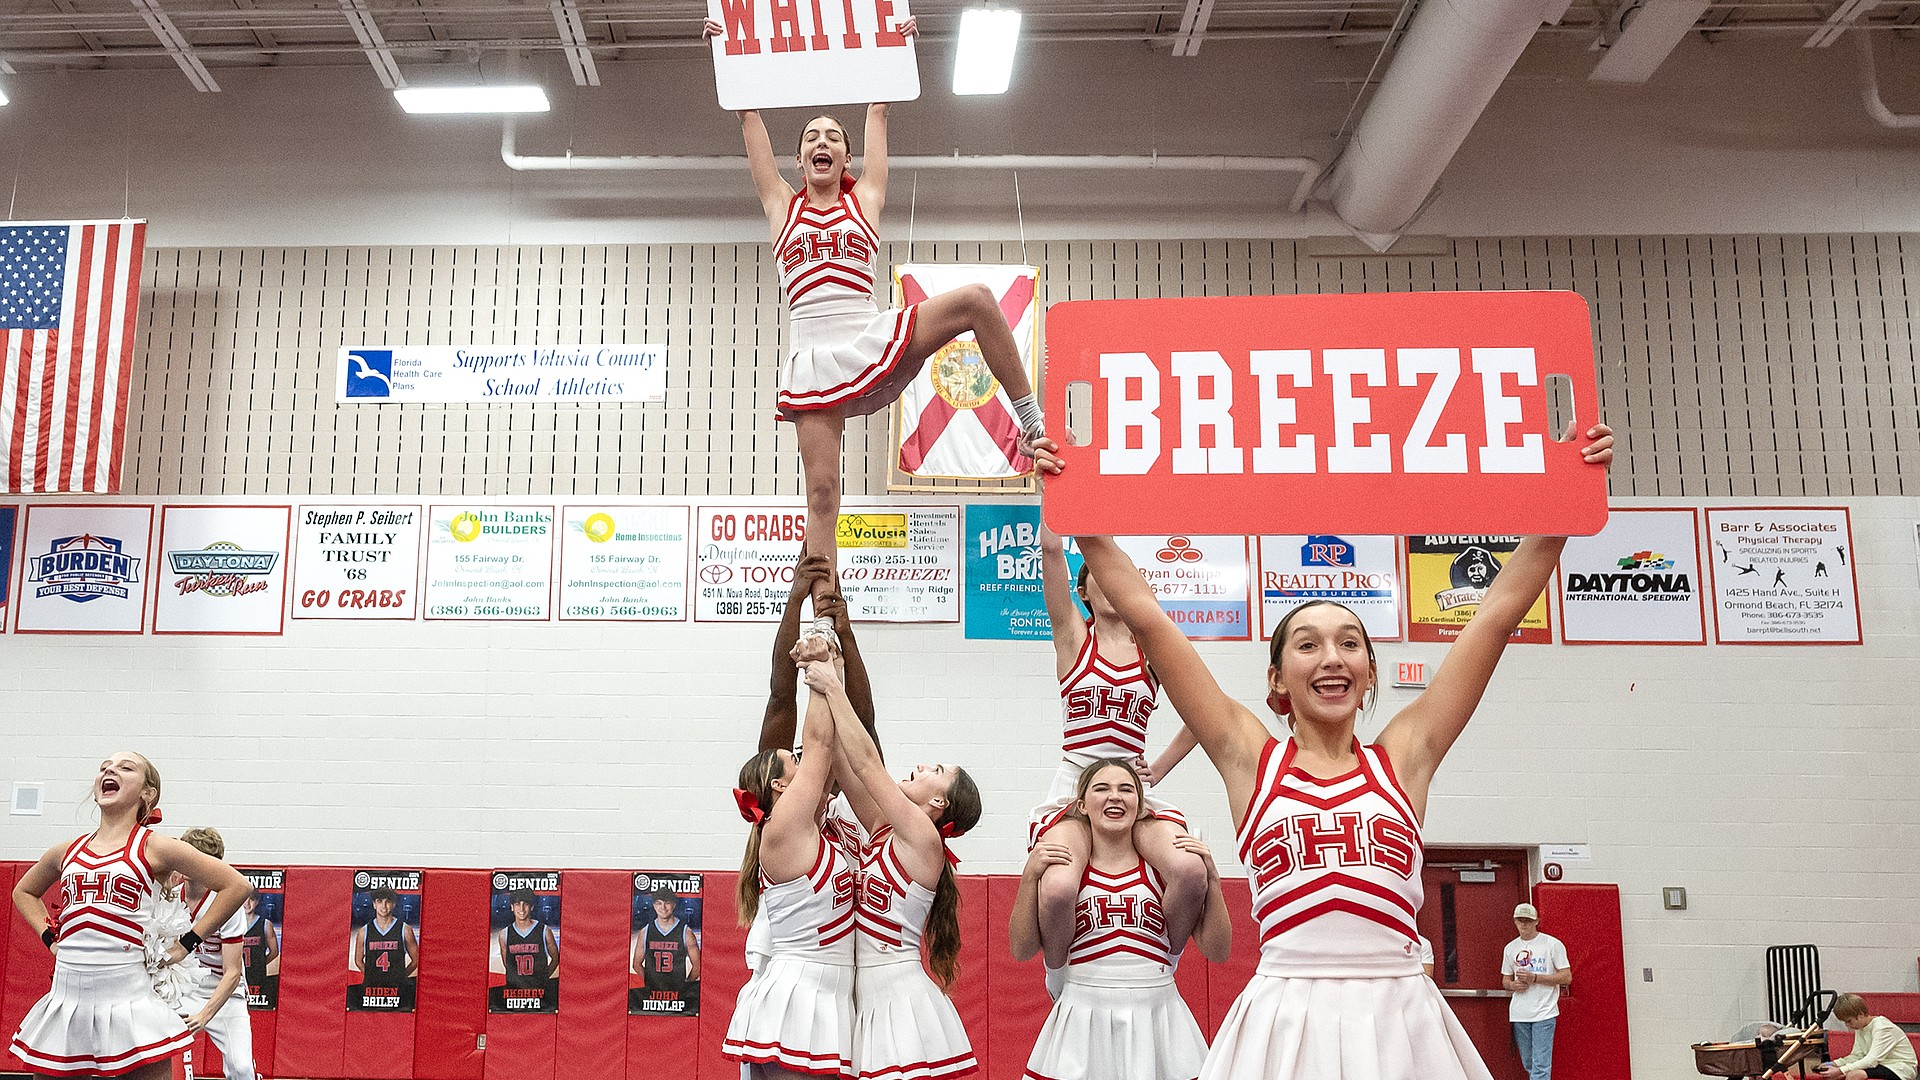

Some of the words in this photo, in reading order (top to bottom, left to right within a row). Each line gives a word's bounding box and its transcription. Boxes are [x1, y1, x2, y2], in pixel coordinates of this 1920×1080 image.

[782, 230, 870, 278] SHS
[453, 350, 526, 373] Supports
[534, 349, 589, 367] Volusia
[596, 349, 656, 370] County
[483, 378, 540, 396] School
[549, 378, 625, 396] Athletics
[1099, 347, 1546, 475] BREEZE
[306, 511, 352, 528] Stephen
[356, 511, 365, 524] P.
[370, 511, 413, 524] Seibert
[460, 511, 498, 522] John
[504, 511, 551, 522] Banks
[483, 526, 546, 534] BUILDERS
[712, 515, 736, 541] GO
[745, 515, 805, 541] CRABS
[854, 528, 906, 539] Volusia
[1721, 523, 1749, 532] Barr
[1755, 523, 1764, 532] &
[1769, 523, 1837, 532] Associates
[318, 532, 397, 544] FAMILY
[615, 533, 636, 541] Home
[638, 533, 682, 542] Inspections
[1425, 536, 1522, 545] ADVENTURE
[1738, 536, 1778, 545] Physical
[1783, 536, 1822, 545] Therapy
[323, 550, 391, 562] TRUST
[455, 555, 470, 563] 155
[473, 555, 509, 564] Fairway
[512, 555, 524, 563] Dr.
[590, 555, 605, 563] 155
[609, 555, 644, 564] Fairway
[648, 555, 660, 563] Dr.
[704, 544, 757, 565] Daytona
[852, 555, 881, 565] (386)
[885, 555, 937, 565] 255-1100
[1309, 544, 1352, 567] RP
[41, 553, 127, 576] BURDEN
[179, 556, 266, 568] DAYTONA
[344, 568, 367, 580] '68
[740, 567, 795, 583] TOYO
[842, 568, 867, 581] GO
[871, 568, 951, 581] BREEZE!
[1139, 568, 1170, 581] Ryan
[1176, 568, 1221, 581] Ochipa
[175, 570, 235, 595] Turkey
[232, 578, 267, 596] Run
[432, 580, 544, 589] JohnInspection@aol.com
[568, 580, 682, 589] JohnInspection@aol.com
[980, 584, 1002, 592] REEF
[1005, 584, 1043, 592] FRIENDL
[1264, 571, 1337, 594] REALTY
[1342, 571, 1391, 589] PROS
[1568, 573, 1690, 593] DAYTONA
[39, 586, 61, 595] YOUR
[86, 585, 126, 596] DEFENSE
[703, 588, 715, 598] 451
[717, 588, 724, 598] N.
[727, 588, 742, 598] Nova
[745, 588, 762, 599] Road,
[929, 586, 953, 594] Ridge
[1150, 584, 1226, 594] 6-677-1119
[302, 590, 330, 608] GO
[338, 590, 406, 609] CRABS
[1443, 591, 1483, 606] Pirate's
[431, 606, 468, 616] (386)
[474, 606, 540, 616] 566-0963
[567, 606, 604, 616] (386)
[610, 606, 677, 616] 566-0963
[717, 602, 742, 614] (386)
[747, 602, 787, 614] 255-74
[1725, 601, 1762, 609] Ormond
[1766, 601, 1797, 610] Beach,
[1800, 601, 1811, 609] FL
[1813, 601, 1843, 609] 32174
[1010, 618, 1033, 627] RON
[1035, 618, 1052, 627] RIC
[1399, 663, 1425, 682] EXIT
[1067, 685, 1159, 732] SHS
[1249, 812, 1417, 896] SHS
[245, 875, 281, 889] NIOR
[370, 877, 418, 890] SENIOR
[509, 878, 557, 891] SENIOR
[651, 880, 700, 893] SENIOR
[1072, 895, 1166, 943] SHS
[376, 952, 390, 971] 4
[516, 955, 534, 975] 10
[654, 952, 674, 972] 13
[650, 991, 678, 999] JOHN
[363, 996, 400, 1008] BAILEY
[506, 998, 541, 1009] GUPTA
[643, 999, 685, 1011] DUNLAP
